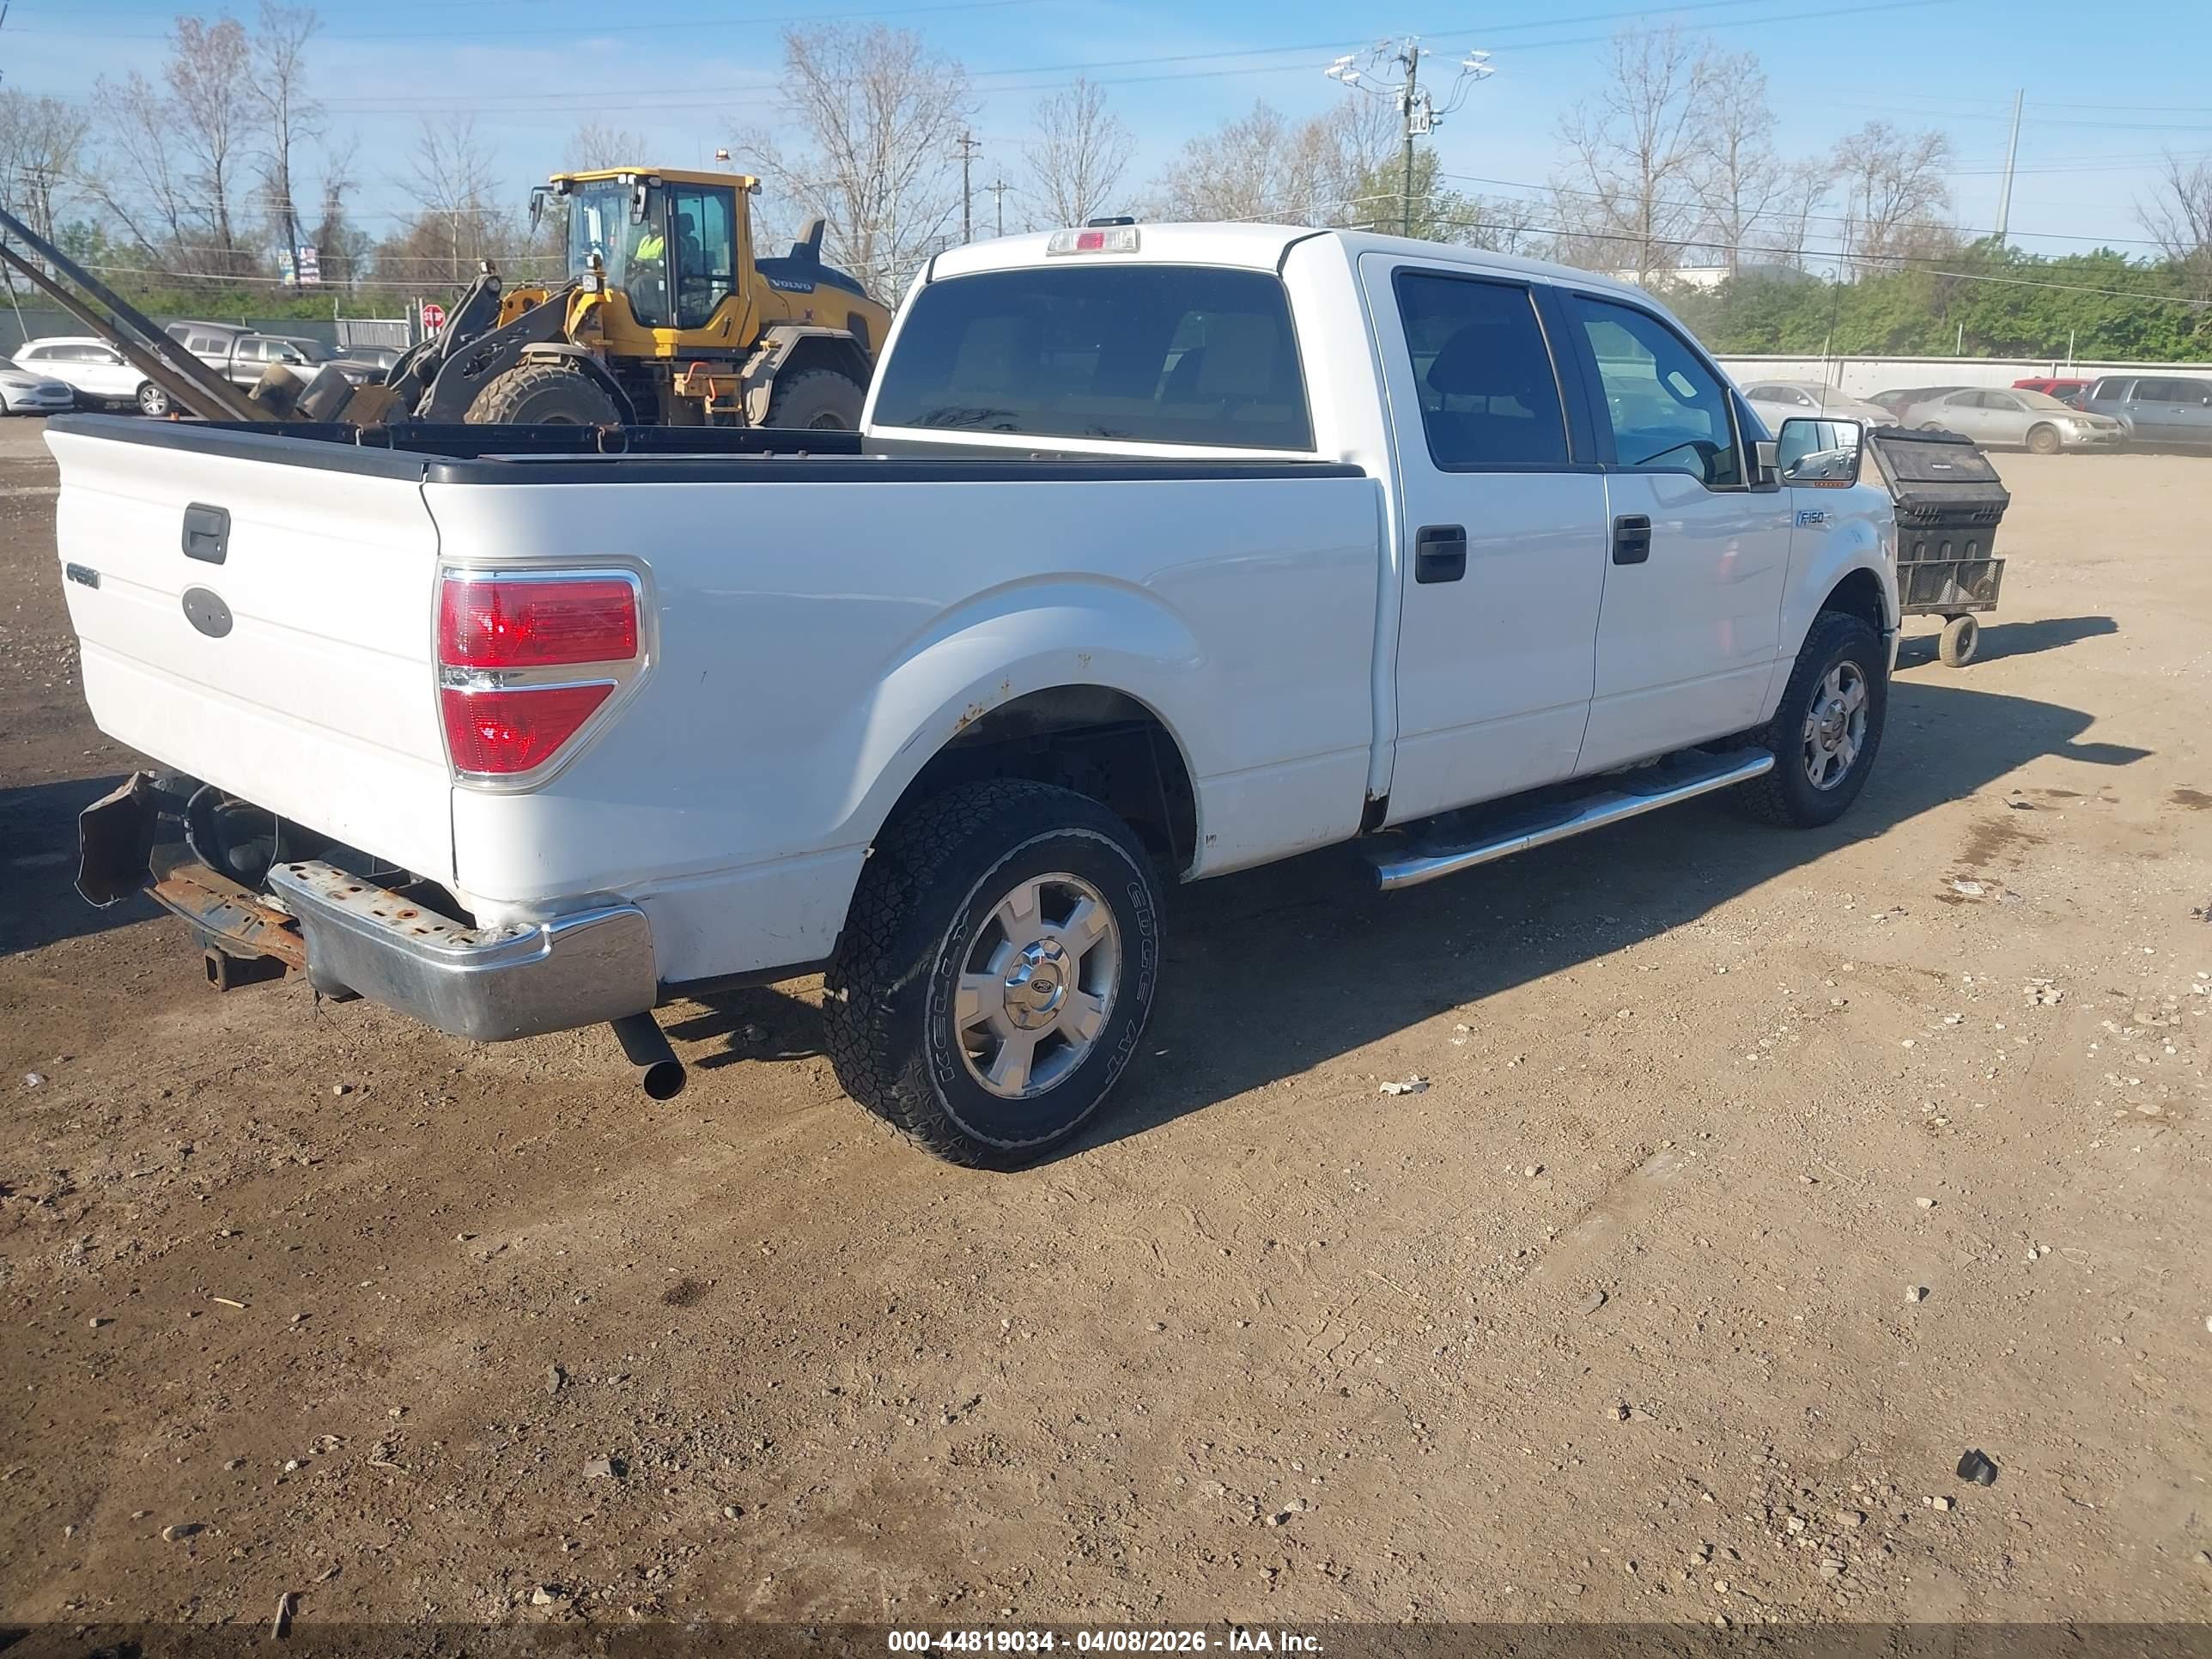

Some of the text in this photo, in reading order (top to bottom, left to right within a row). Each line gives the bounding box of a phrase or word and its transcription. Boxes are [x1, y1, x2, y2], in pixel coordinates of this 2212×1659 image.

[770, 278, 811, 290] VOLVO
[1799, 511, 1825, 525] F-150
[1126, 881, 1153, 1005] EDGE
[933, 908, 970, 1083] KELLY
